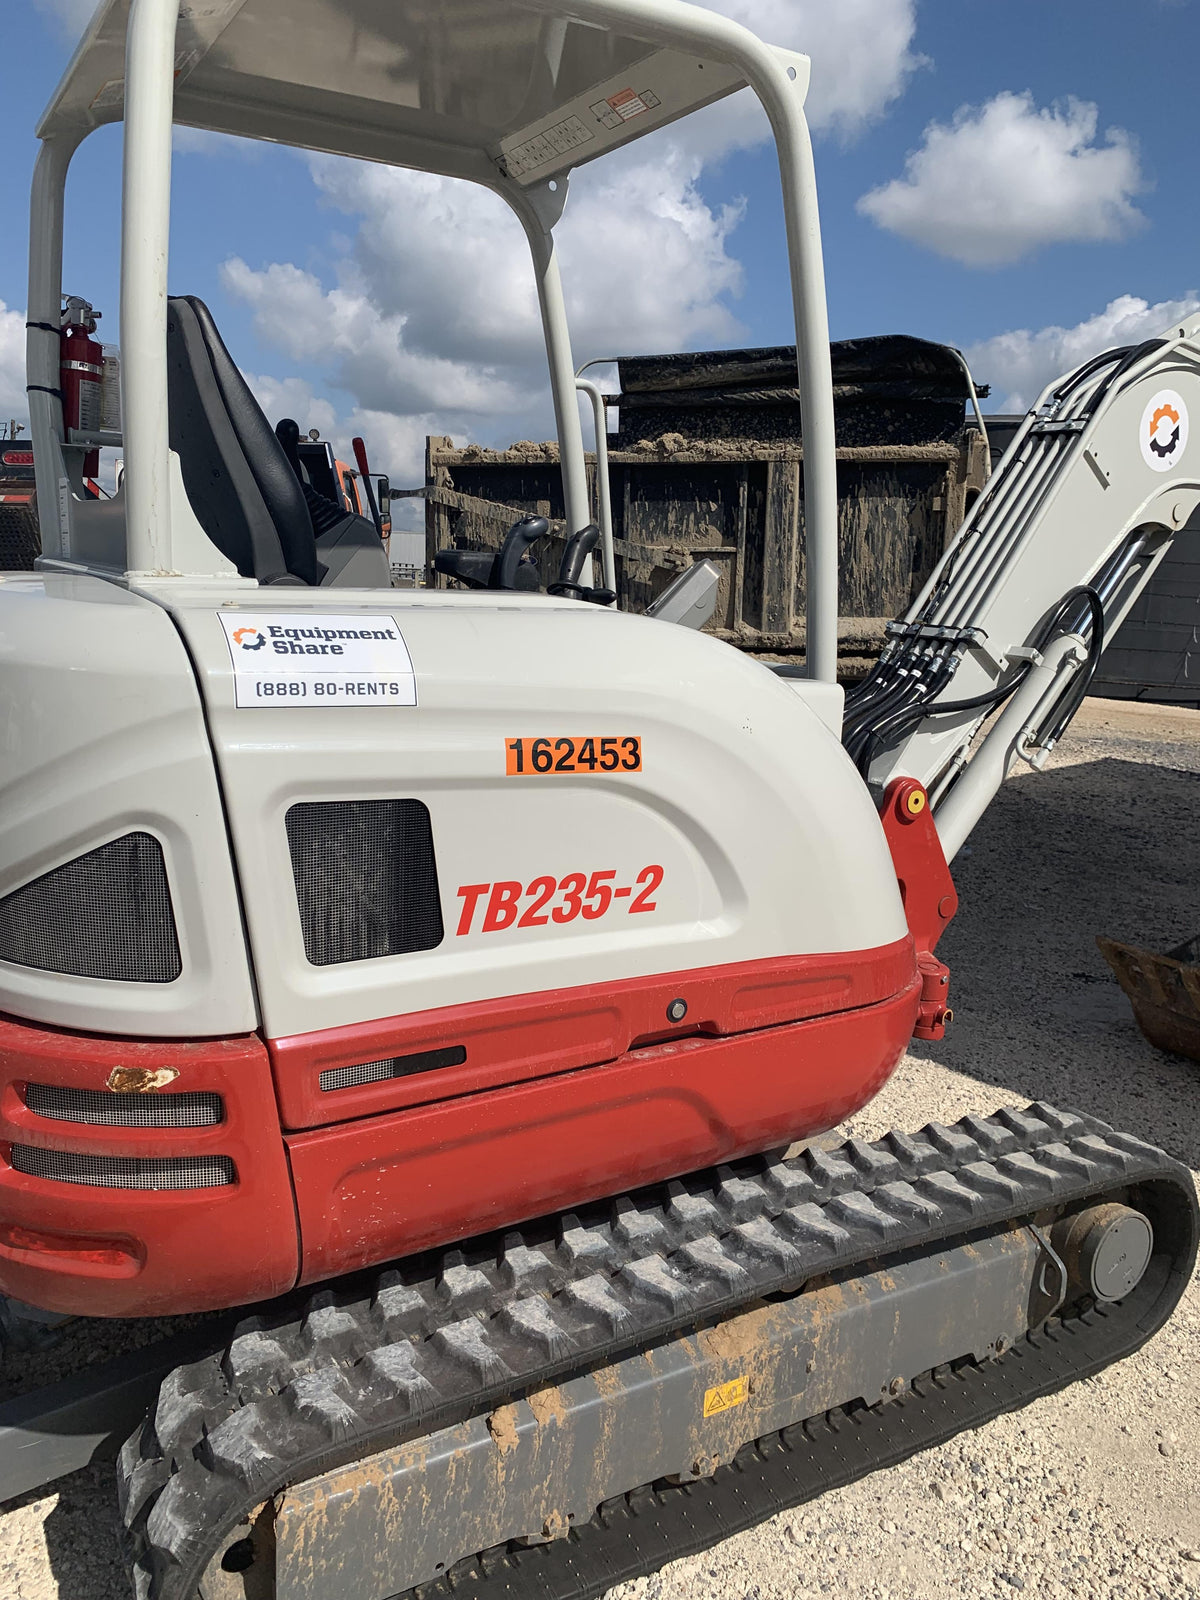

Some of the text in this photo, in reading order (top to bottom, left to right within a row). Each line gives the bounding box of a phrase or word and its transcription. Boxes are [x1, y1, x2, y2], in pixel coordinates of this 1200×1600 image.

[267, 625, 397, 642] Equipment
[256, 682, 399, 697] (888) 80-RENTS
[509, 737, 641, 773] 162453
[456, 865, 665, 937] TB235-2
